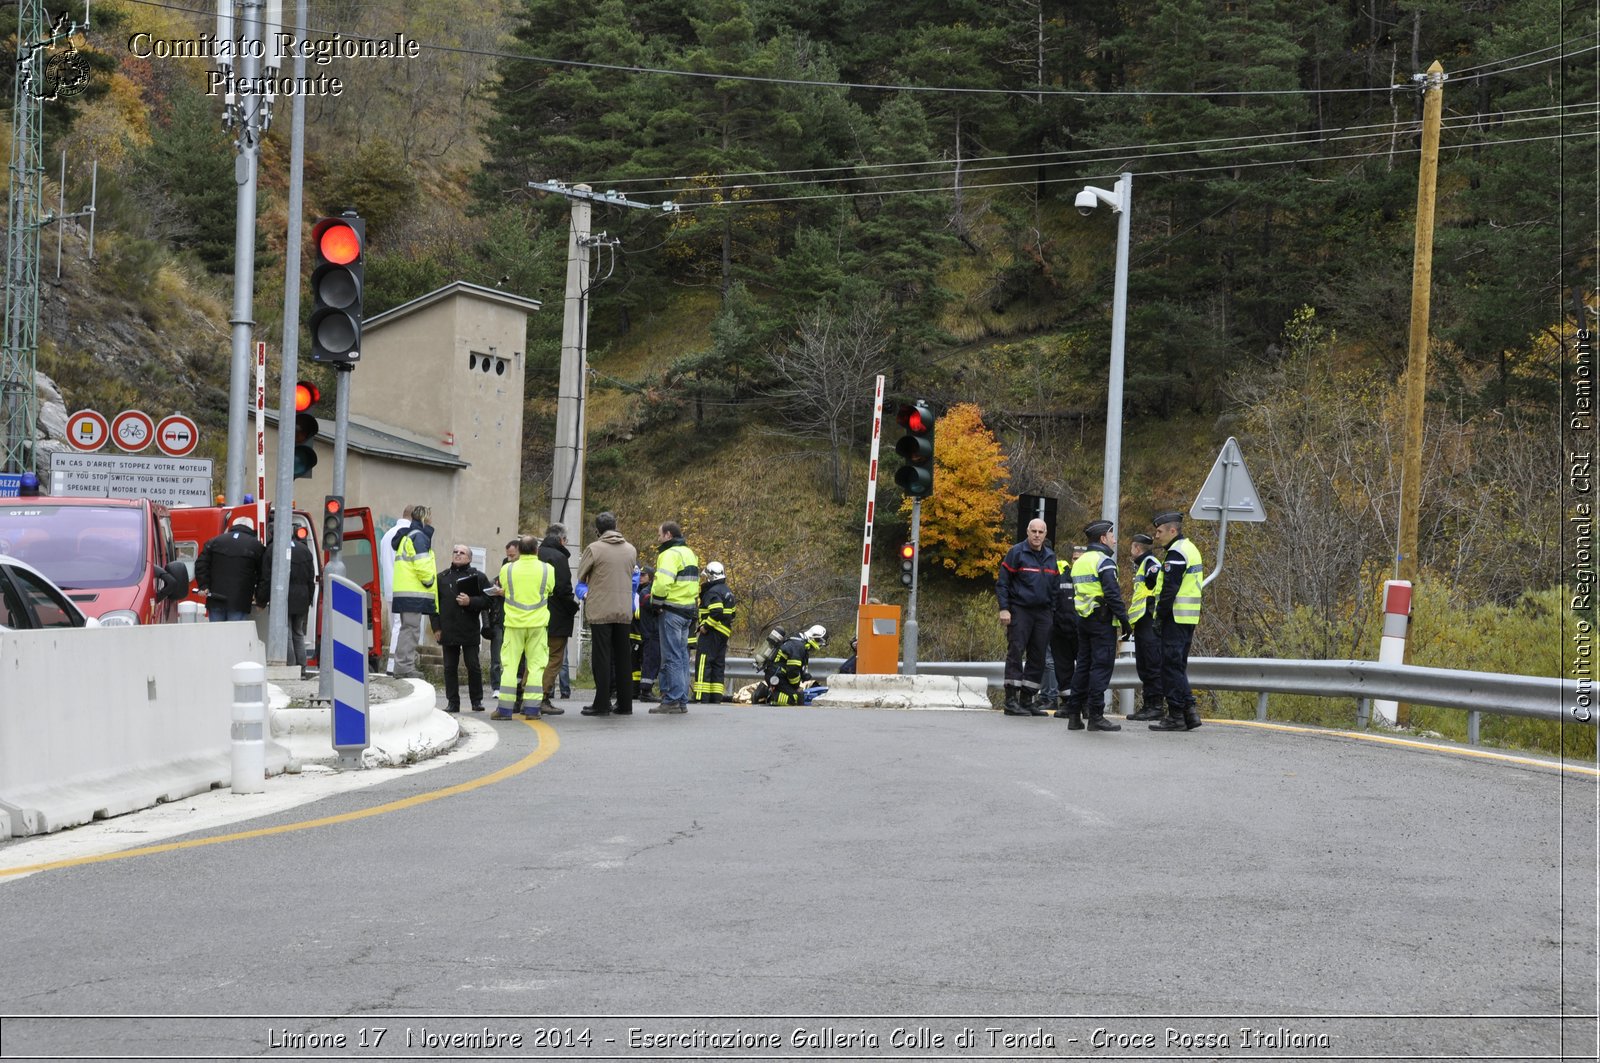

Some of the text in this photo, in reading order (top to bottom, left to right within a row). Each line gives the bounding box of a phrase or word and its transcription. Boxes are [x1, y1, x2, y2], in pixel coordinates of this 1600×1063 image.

[119, 462, 151, 470] STOPPEZ
[157, 476, 180, 484] ENGINE
[67, 484, 101, 492] SPEGNERE
